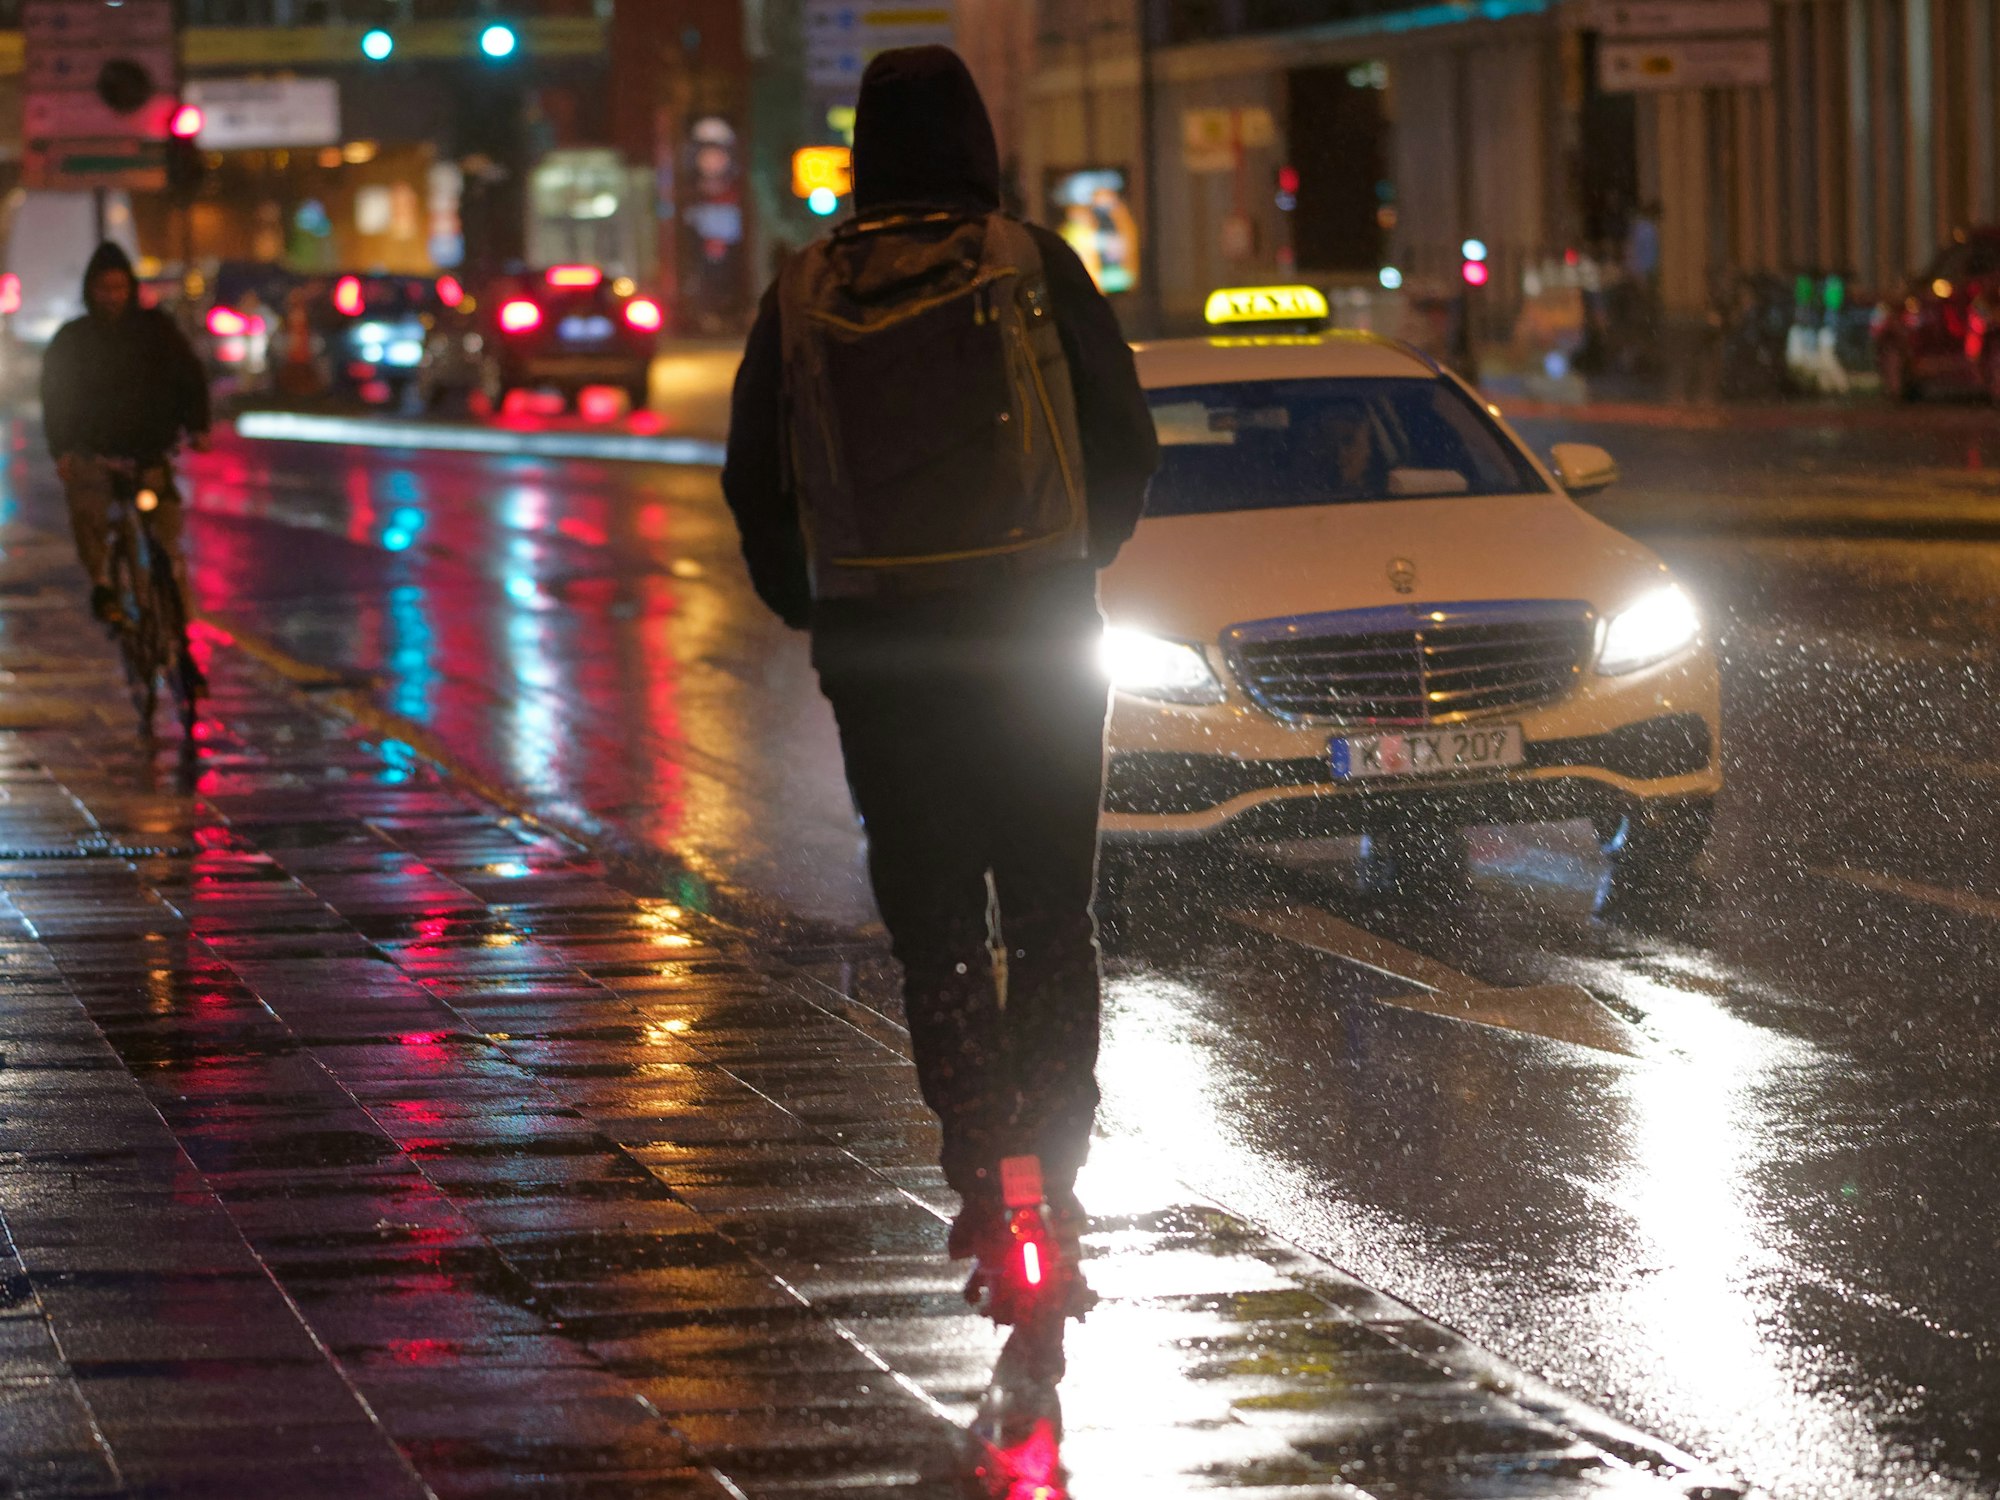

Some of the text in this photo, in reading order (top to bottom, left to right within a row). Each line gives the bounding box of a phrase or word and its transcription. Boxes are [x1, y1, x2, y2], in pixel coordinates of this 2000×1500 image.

[1229, 289, 1308, 314] TAXI
[1362, 741, 1382, 769] K
[1403, 735, 1444, 767] TX
[1452, 731, 1508, 763] 207
